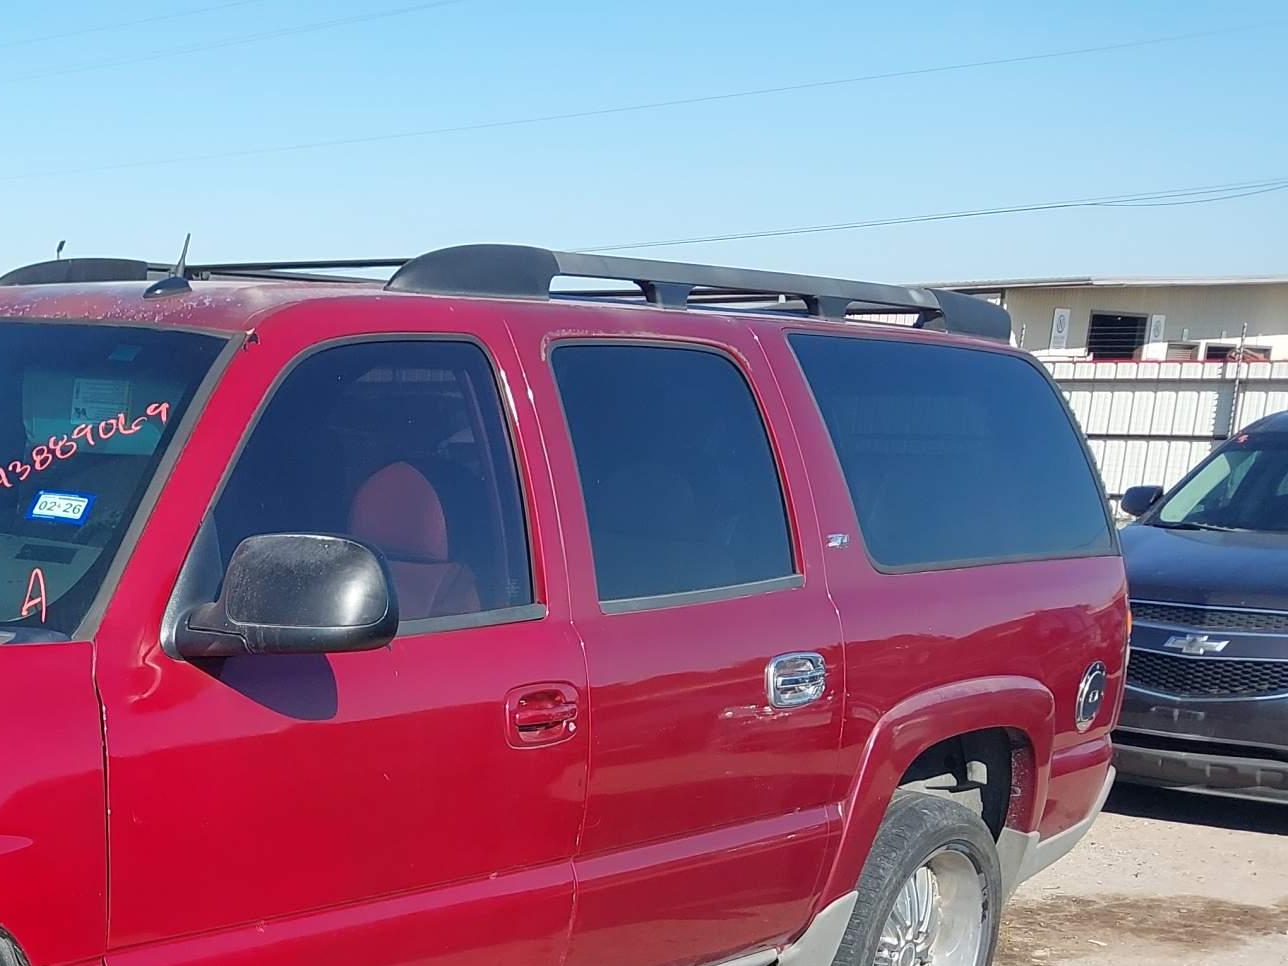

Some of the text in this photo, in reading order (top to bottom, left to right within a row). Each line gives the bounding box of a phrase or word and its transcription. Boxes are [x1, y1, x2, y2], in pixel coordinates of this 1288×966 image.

[38, 500, 82, 515] 02 26
[21, 567, 46, 623] A
